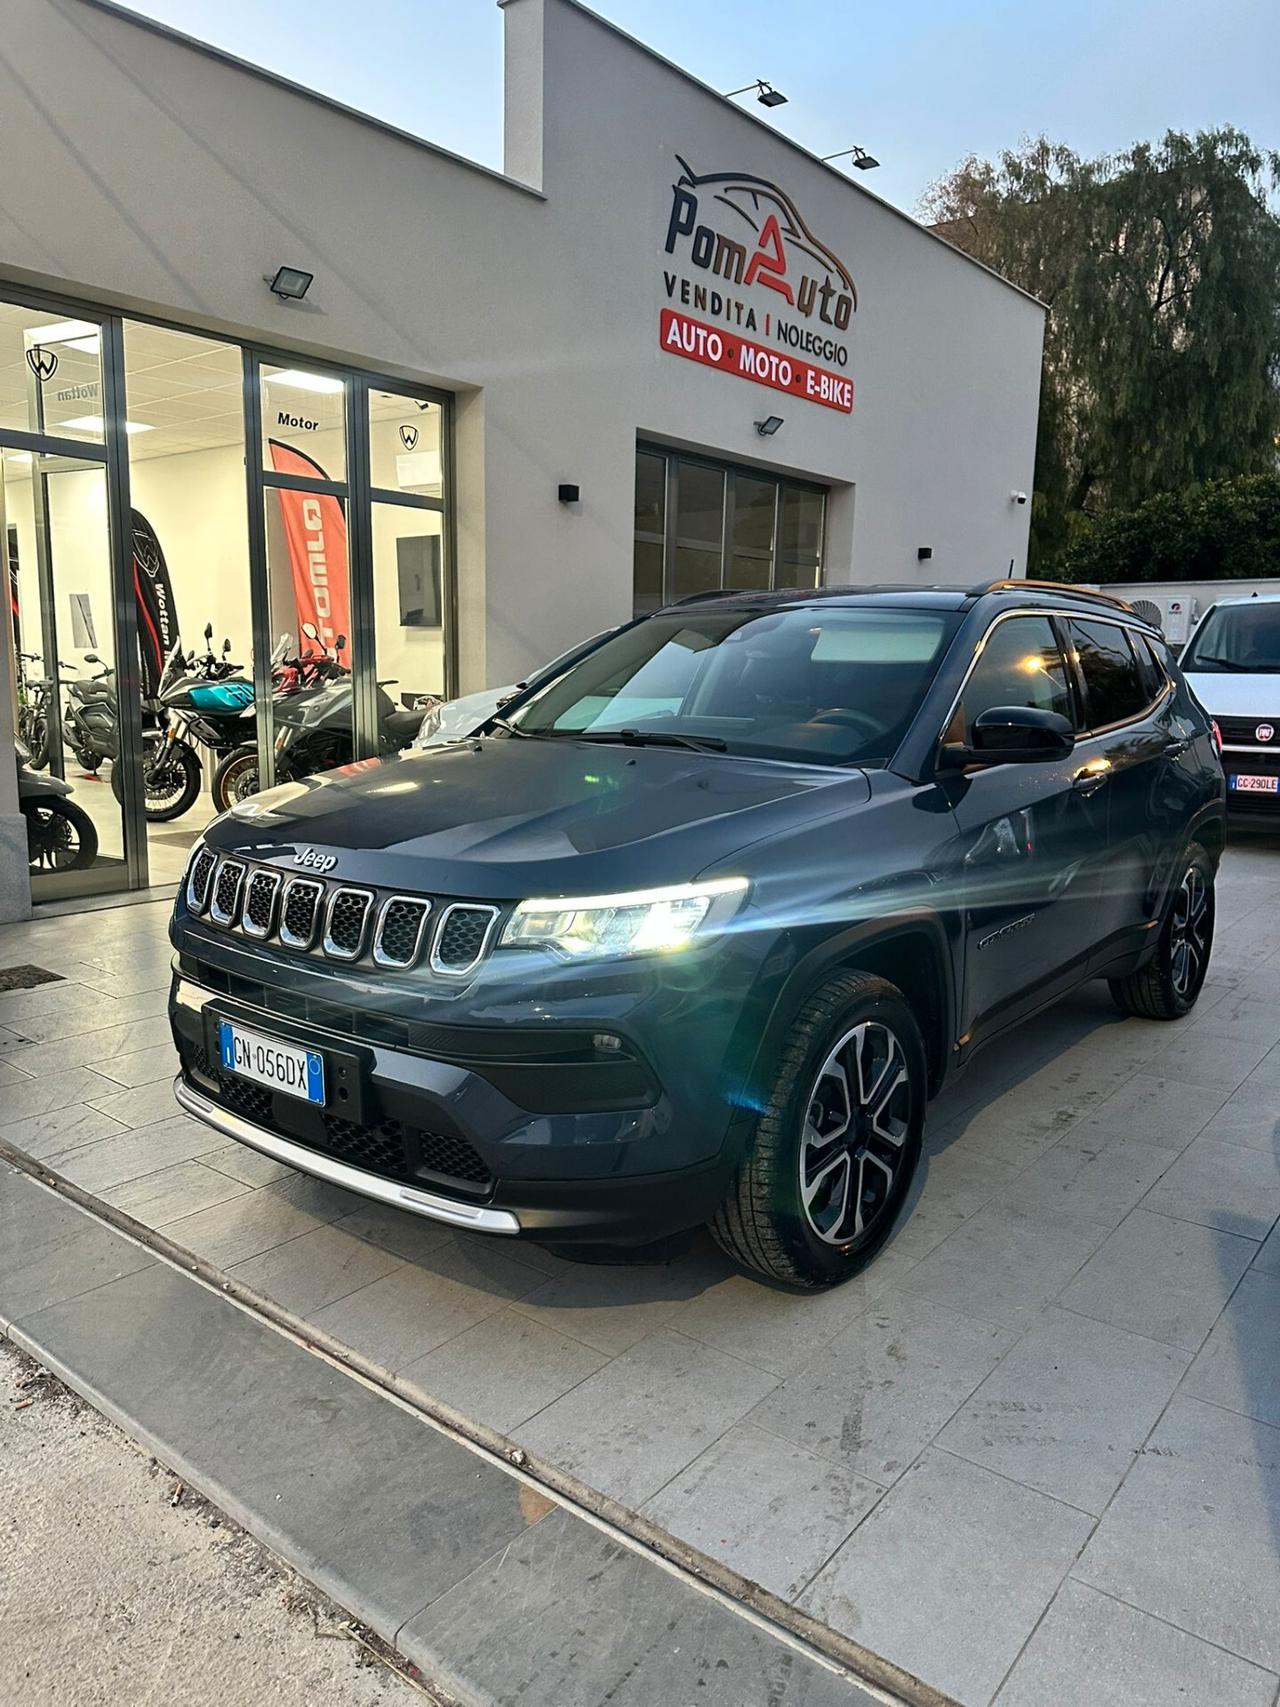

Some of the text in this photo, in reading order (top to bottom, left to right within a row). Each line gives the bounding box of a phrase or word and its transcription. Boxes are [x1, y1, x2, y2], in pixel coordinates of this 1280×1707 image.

[663, 271, 848, 367] VENDITA NOLEGGIO
[666, 318, 852, 408] AUTO MOTO E-BIKE
[277, 412, 319, 431] Motor
[154, 583, 171, 645] Wottan
[293, 847, 337, 873] Jeep
